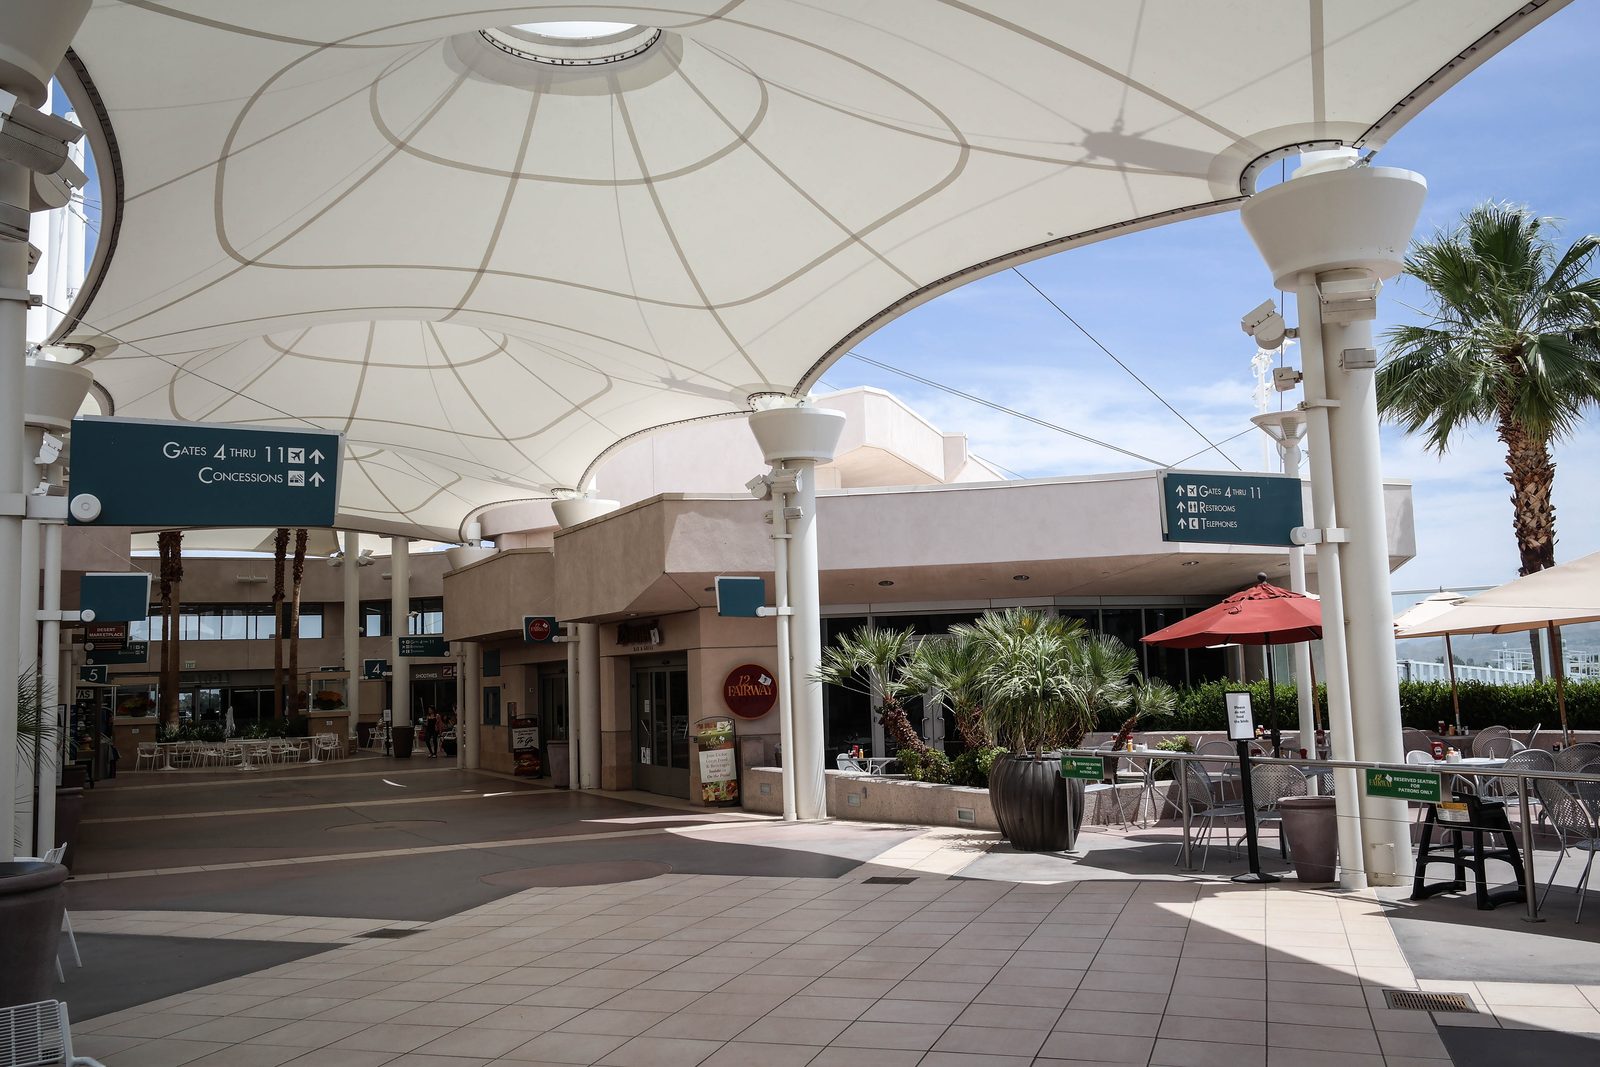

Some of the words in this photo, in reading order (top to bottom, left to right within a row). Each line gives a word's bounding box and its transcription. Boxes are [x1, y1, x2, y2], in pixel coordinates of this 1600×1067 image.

[163, 441, 207, 459] GATES
[213, 444, 227, 461] 4
[229, 448, 256, 459] THRU
[265, 446, 284, 463] 11
[198, 466, 283, 484] CONCESSIONS
[1199, 485, 1222, 498] GATES
[1224, 486, 1232, 498] 4
[1232, 488, 1247, 496] THRU
[1250, 486, 1261, 499] 11
[1199, 501, 1236, 513] RESTROOMS
[1200, 517, 1238, 530] TELEPHONES
[88, 668, 98, 682] 5
[372, 663, 381, 675] 4
[739, 674, 751, 686] 12
[728, 684, 772, 697] FAIRWAY
[1393, 776, 1417, 784] RESERVED
[1417, 777, 1438, 785] SEATING
